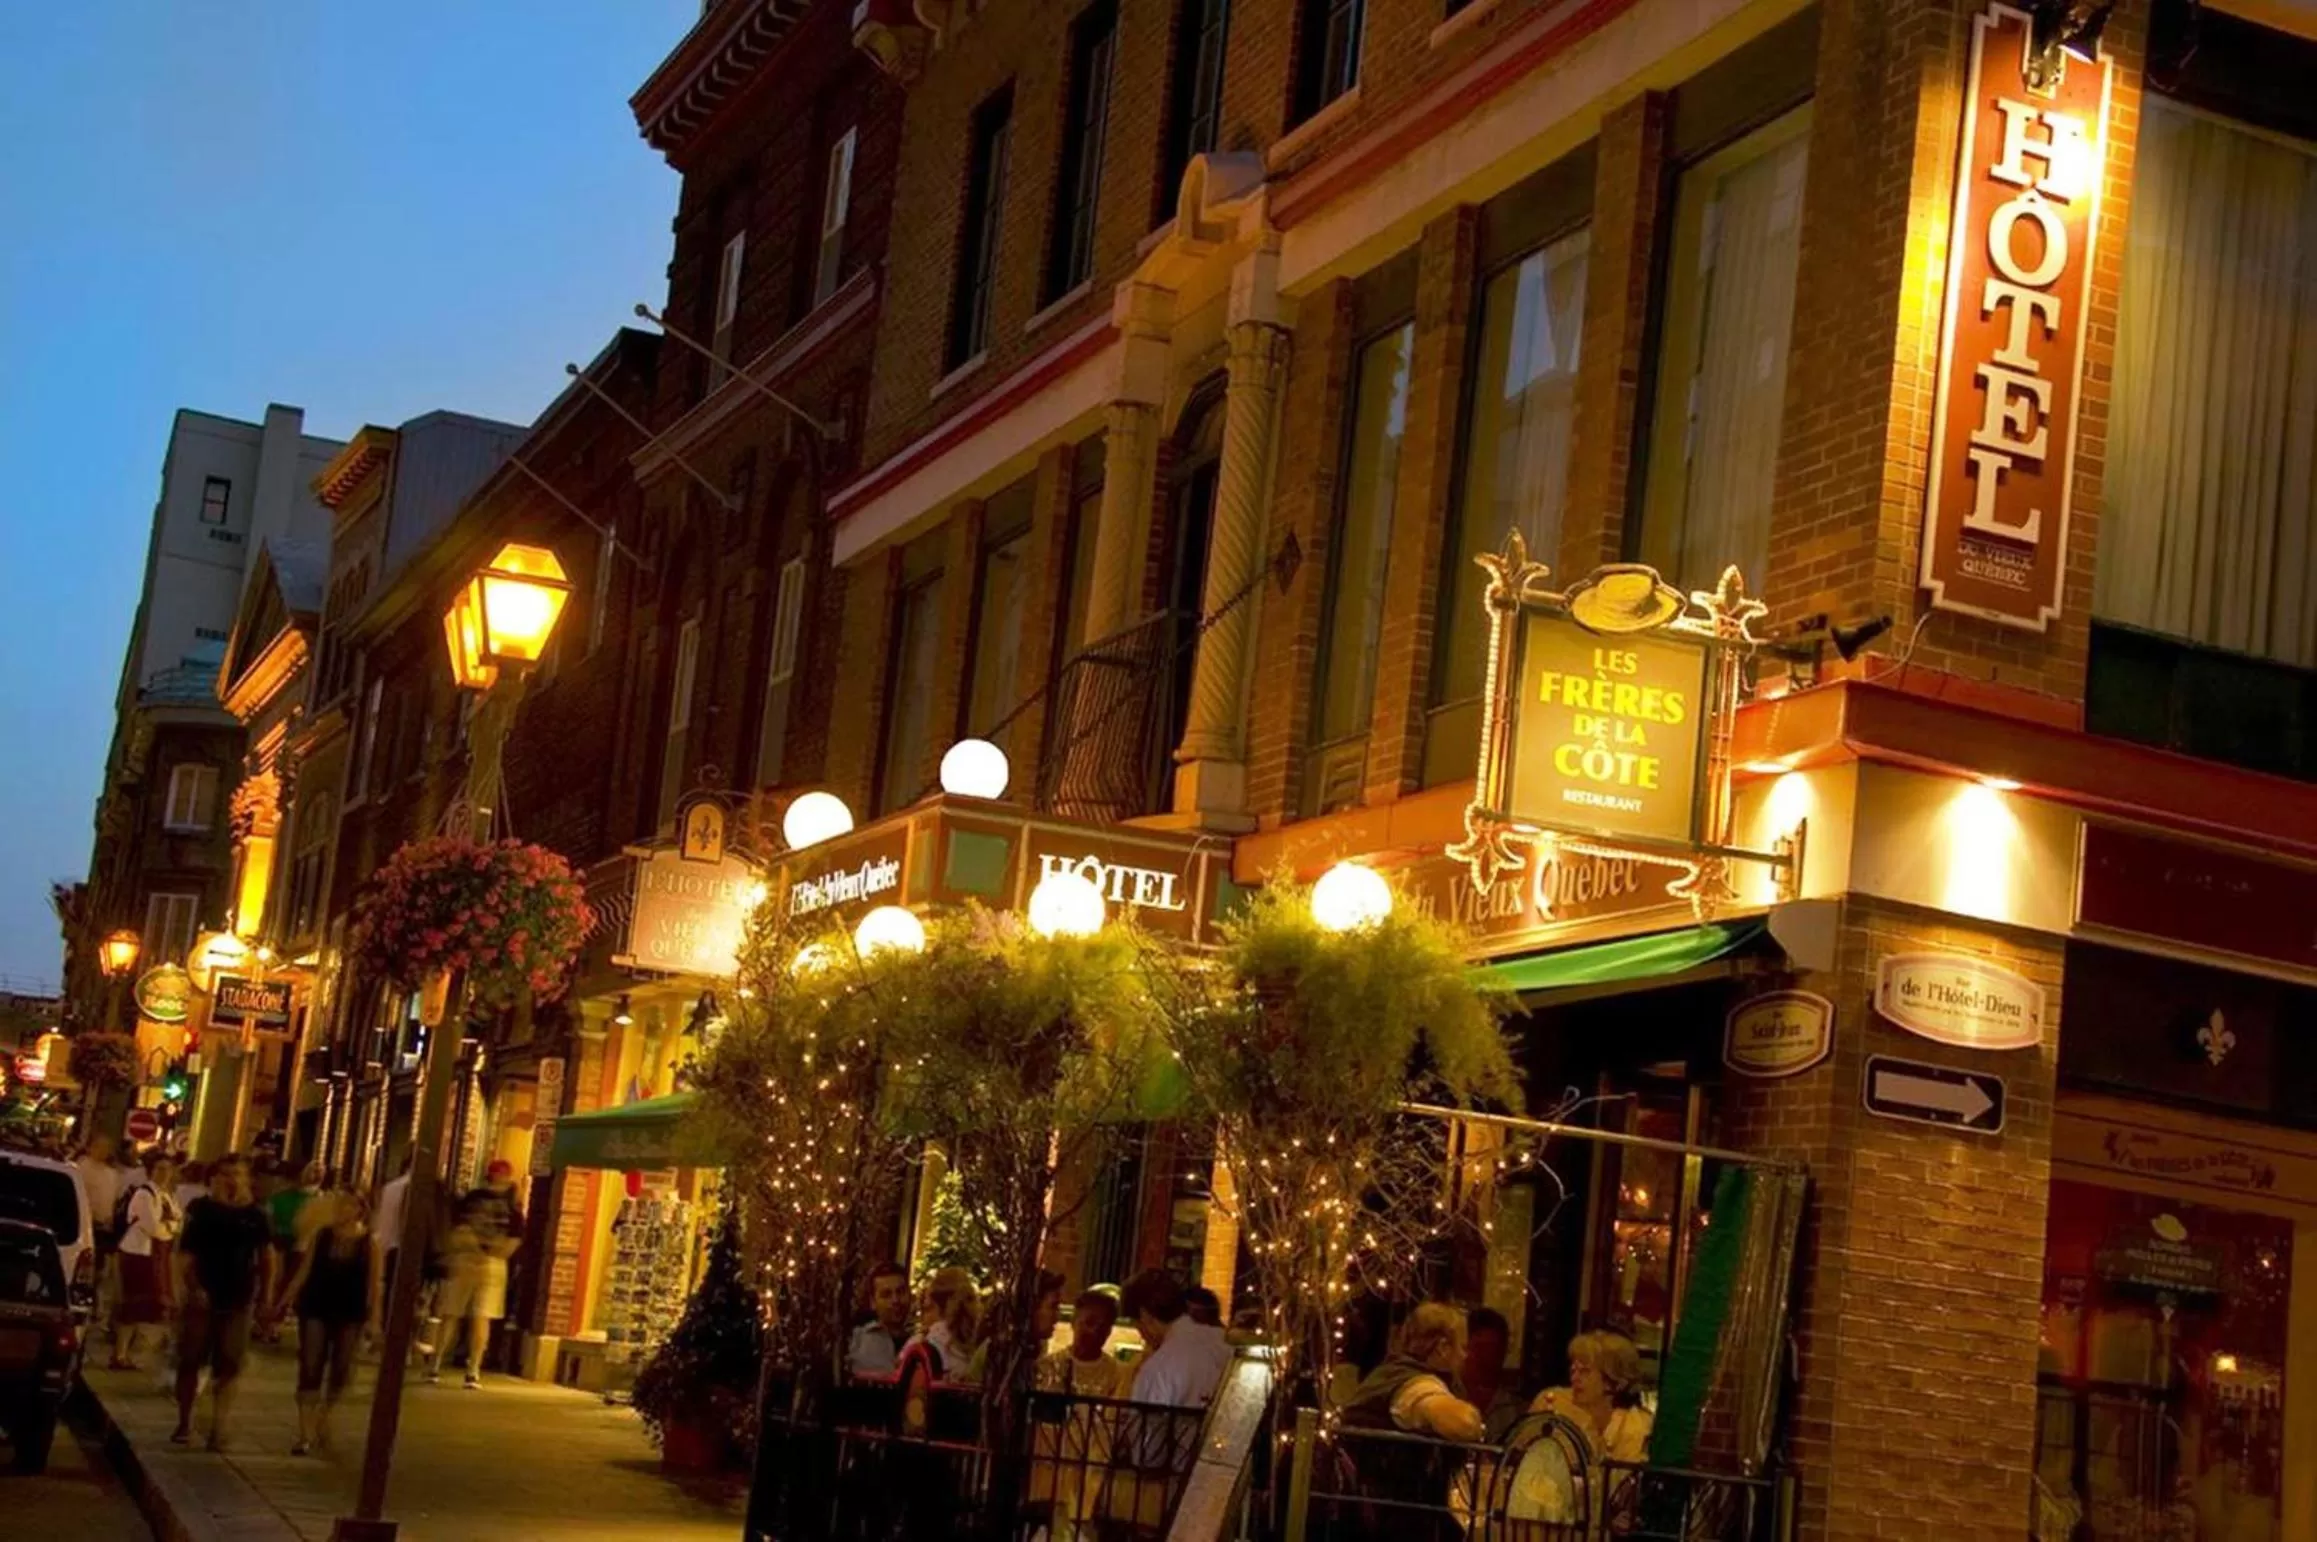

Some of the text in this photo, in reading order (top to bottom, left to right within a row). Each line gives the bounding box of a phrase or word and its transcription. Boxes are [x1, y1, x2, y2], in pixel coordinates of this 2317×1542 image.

[1963, 97, 2088, 544] HÔTEL
[1593, 648, 1638, 675] LES
[1539, 670, 1686, 725] FRÈRES
[1572, 713, 1648, 746] DE LA
[1553, 739, 1661, 790] CÔTE
[1562, 788, 1644, 813] RESTAURANT
[1038, 854, 1186, 911] HÔTEL
[1450, 873, 1526, 926] Vieux
[1901, 976, 1921, 997] de
